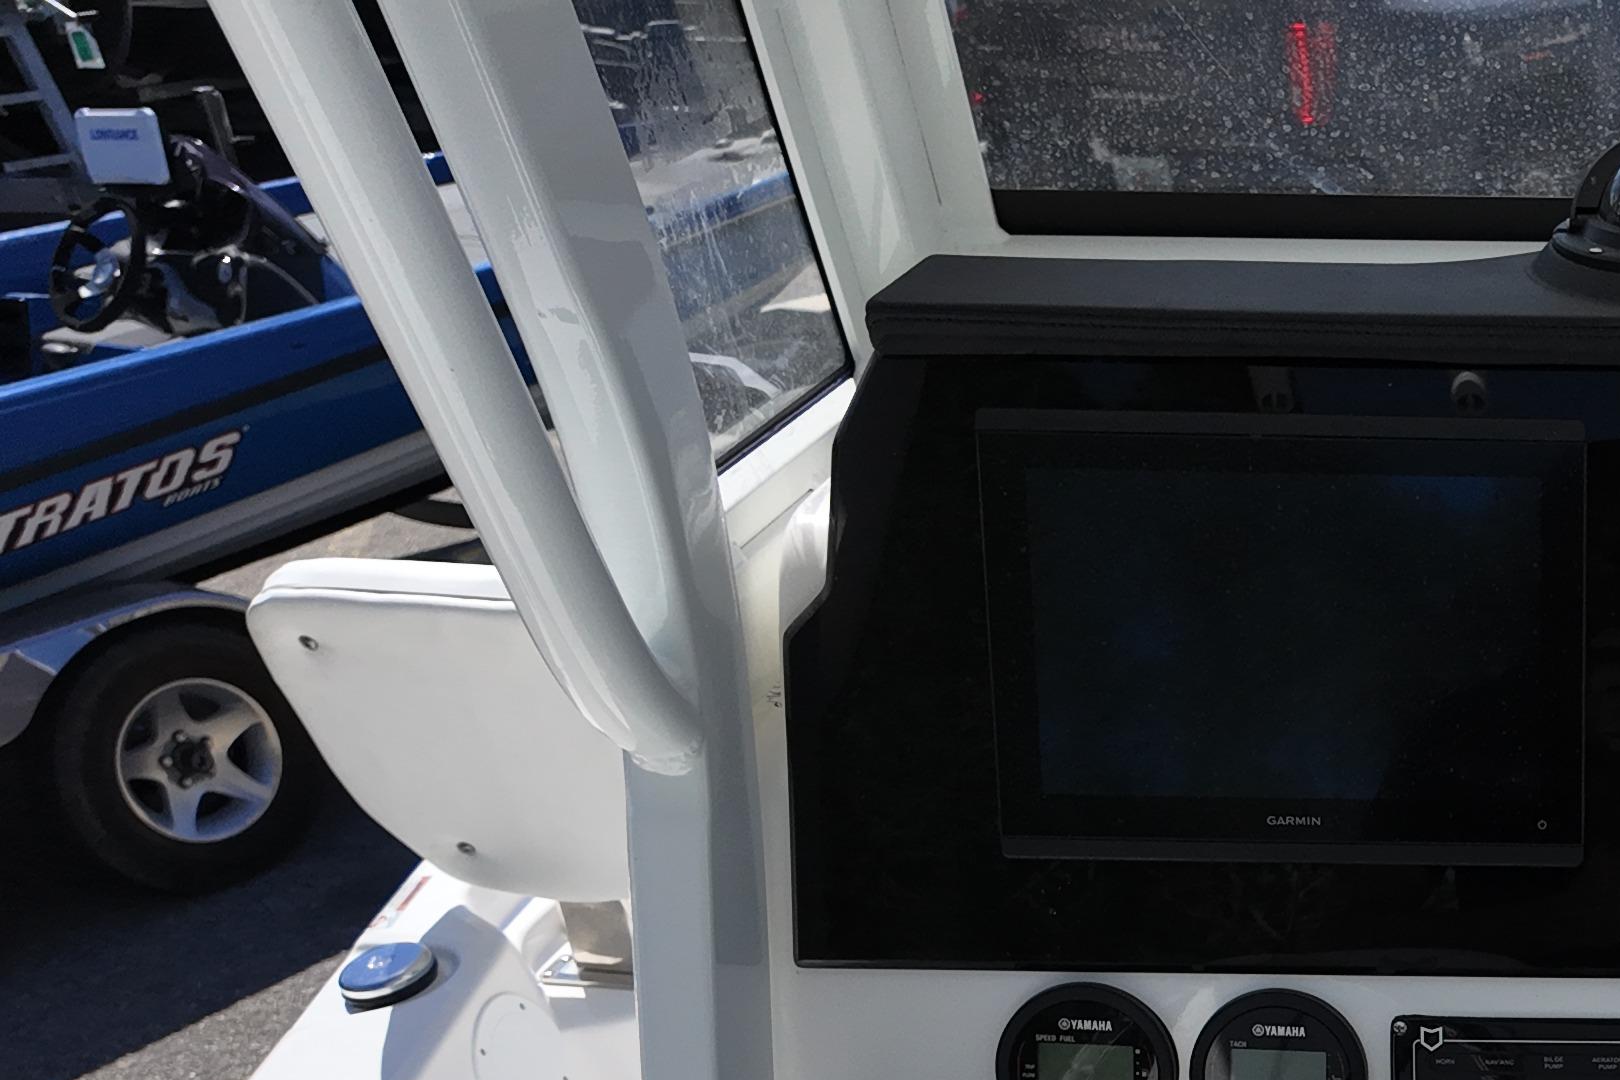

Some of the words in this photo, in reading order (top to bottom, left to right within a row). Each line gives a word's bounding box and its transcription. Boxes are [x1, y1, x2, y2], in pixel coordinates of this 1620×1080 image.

[0, 431, 243, 555] TRATOS
[1266, 814, 1322, 826] GARMIN
[1071, 1019, 1112, 1032] YAMAHA
[1036, 1034, 1056, 1042] SPEED
[1060, 1034, 1076, 1042] FUEL
[1264, 1026, 1306, 1038] YAMAHA
[1229, 1040, 1248, 1048] TACH
